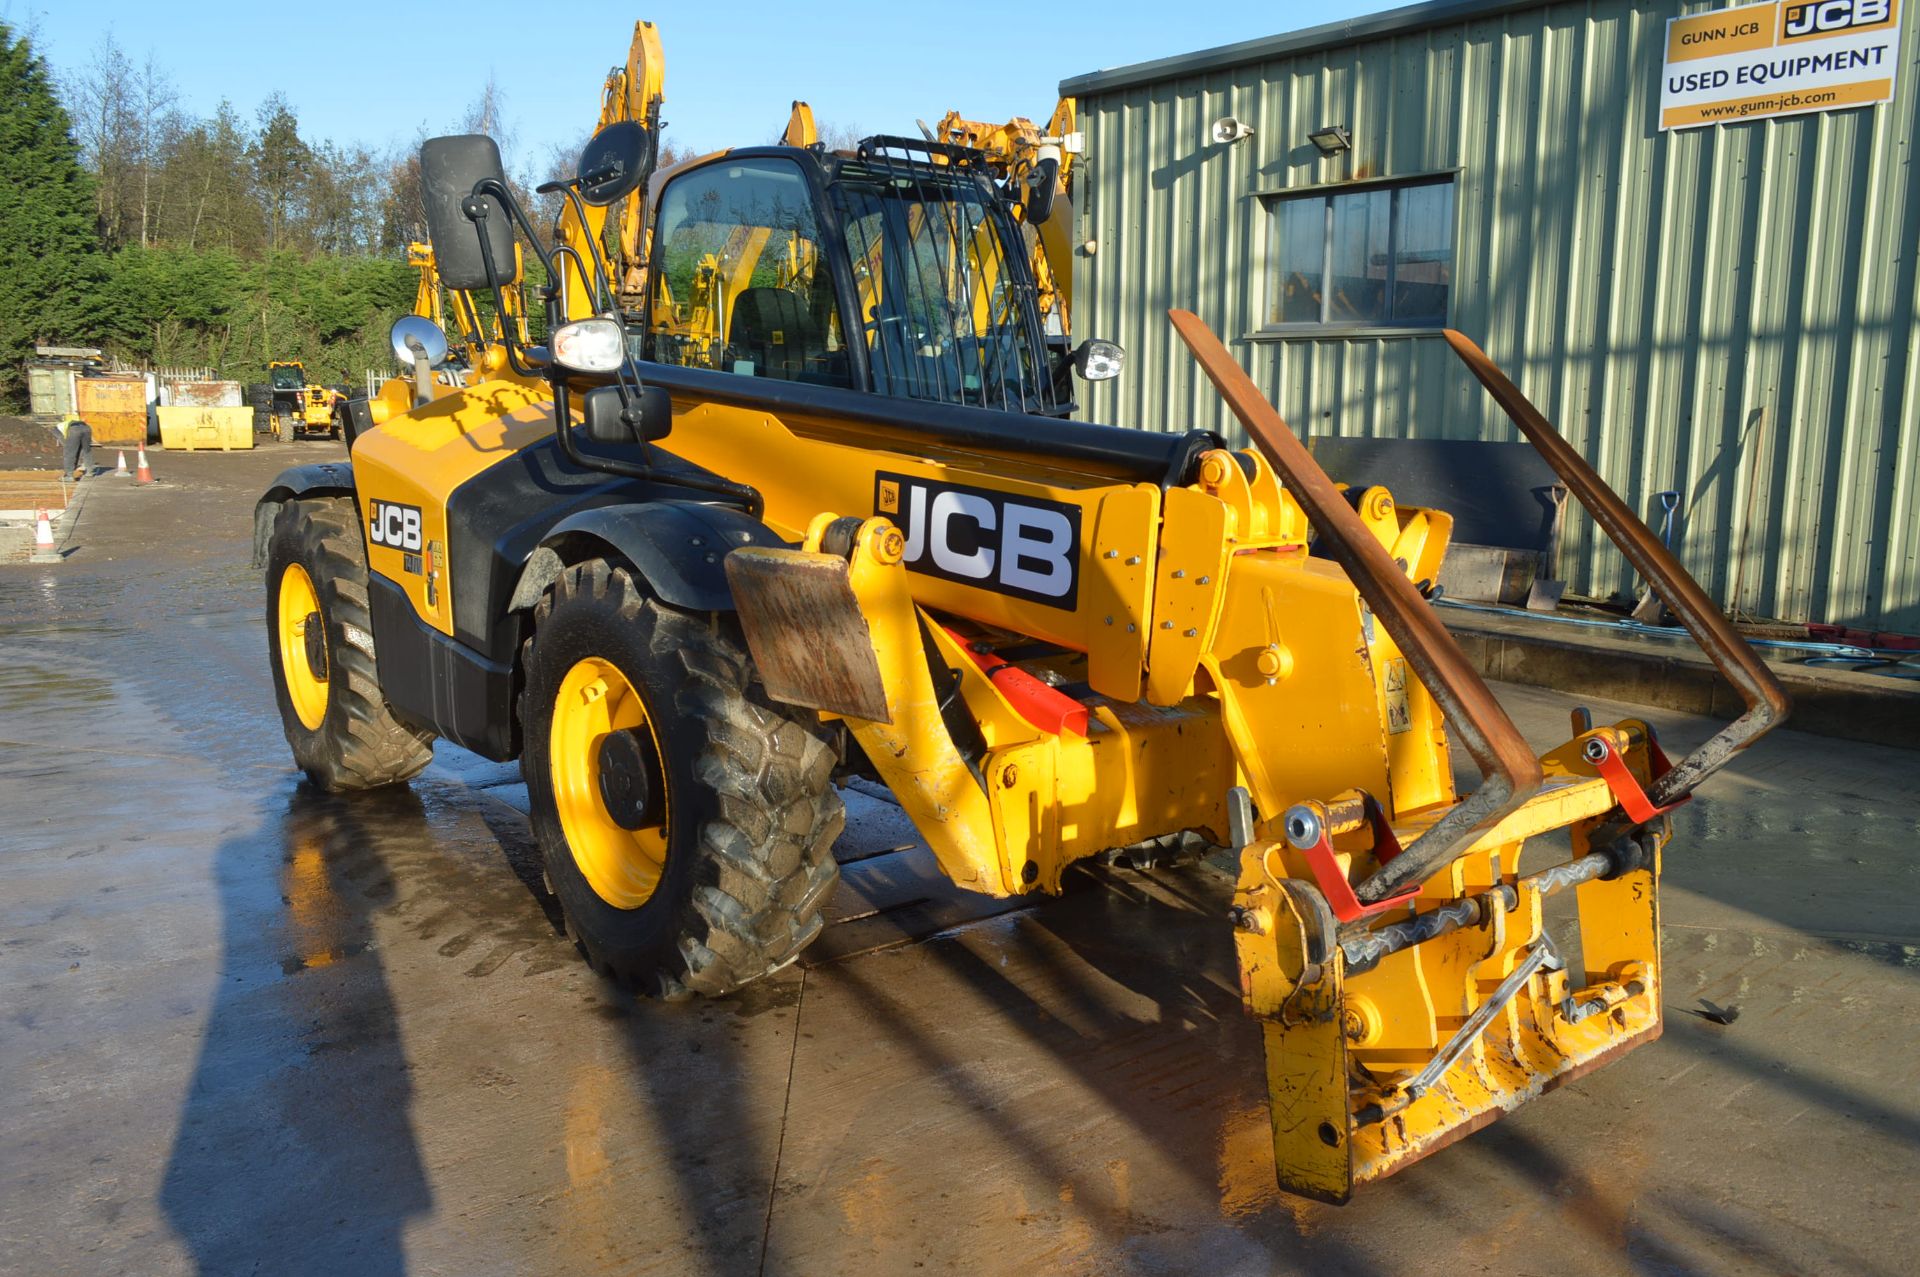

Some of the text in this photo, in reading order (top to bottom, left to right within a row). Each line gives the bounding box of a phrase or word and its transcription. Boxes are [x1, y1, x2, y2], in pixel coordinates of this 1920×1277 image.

[1681, 22, 1760, 46] GUNN JCB
[1786, 0, 1888, 35] JCB
[1668, 45, 1888, 94] USED EQUIPMENT
[1700, 91, 1836, 118] www.gunn-jcb.com
[371, 504, 422, 550] JCB
[903, 485, 1072, 597] JCB
